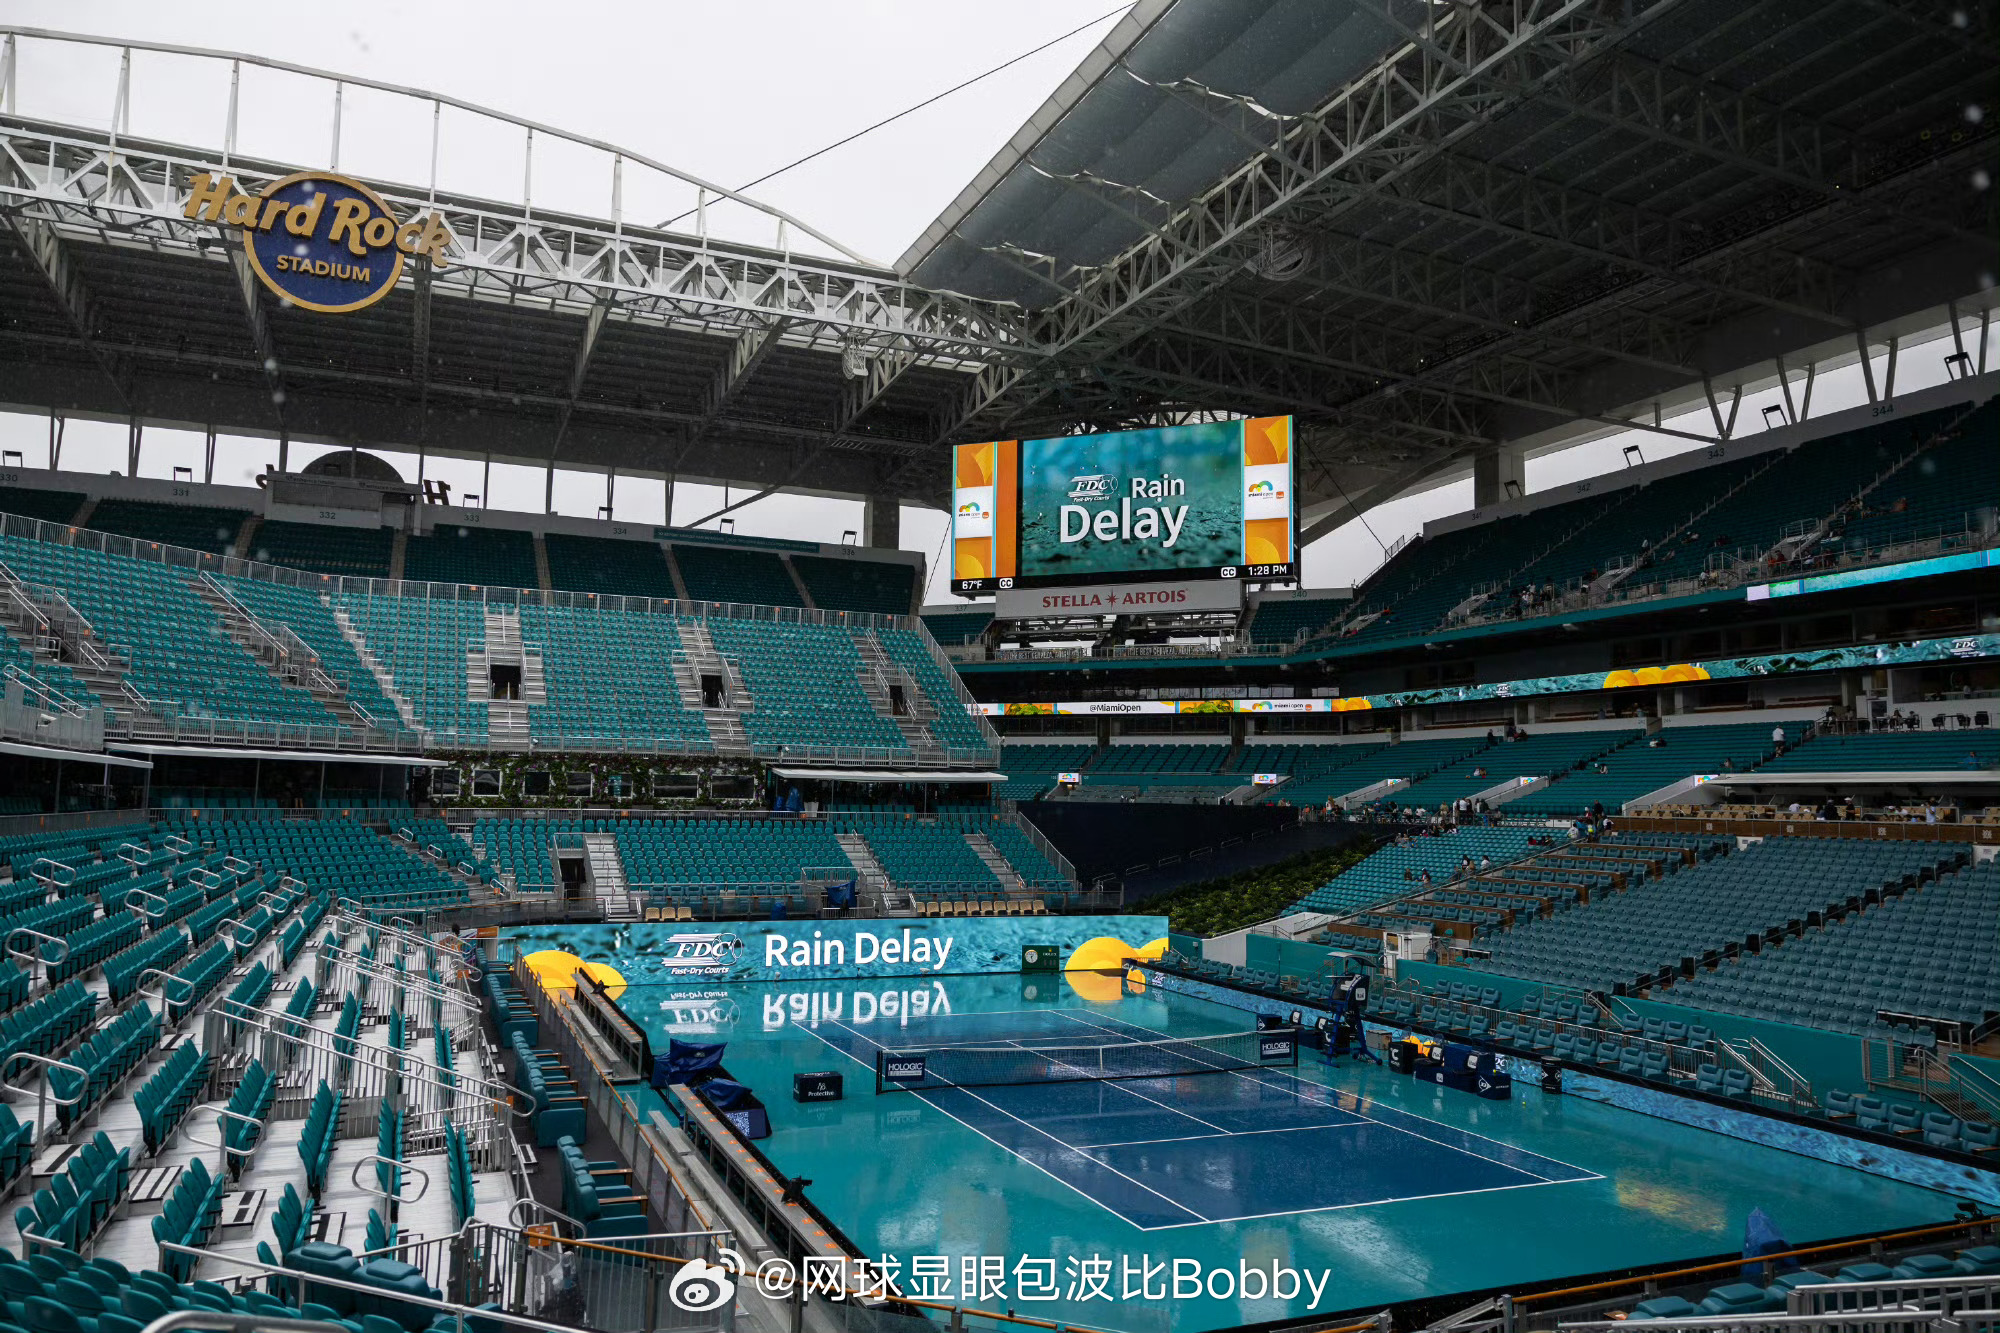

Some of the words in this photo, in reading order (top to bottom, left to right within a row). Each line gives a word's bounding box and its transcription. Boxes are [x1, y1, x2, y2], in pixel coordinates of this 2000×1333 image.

[183, 173, 327, 237] Hard
[328, 197, 451, 268] Rock
[276, 255, 370, 283] STADIUM
[1872, 404, 1894, 417] 344
[1708, 448, 1725, 460] 343
[1076, 479, 1110, 492] FDC
[1132, 473, 1185, 499] Rain
[1577, 483, 1591, 494] 342
[172, 488, 189, 497] 331
[319, 511, 336, 520] 332
[464, 514, 480, 523] 333
[1471, 512, 1482, 521] 341
[1060, 497, 1189, 548] Delay
[612, 527, 627, 536] 334
[1222, 568, 1235, 576] CC
[1248, 565, 1270, 576] 1:28
[1273, 565, 1287, 575] PM
[962, 580, 983, 590] 67°F
[1000, 579, 1013, 587] CC
[1042, 594, 1102, 608] STELLA
[1122, 589, 1187, 605] ARTOIS
[1955, 640, 1979, 649] FDC
[1089, 702, 1141, 713] @MiamiOpen
[674, 941, 731, 958] FDC
[765, 930, 844, 967] Rain
[855, 928, 954, 970] Delay
[671, 967, 703, 976] Fast-Dry
[704, 966, 730, 975] Courts
[1262, 1041, 1290, 1051] HOLOGIC
[888, 1062, 924, 1071] HOLOGIC
